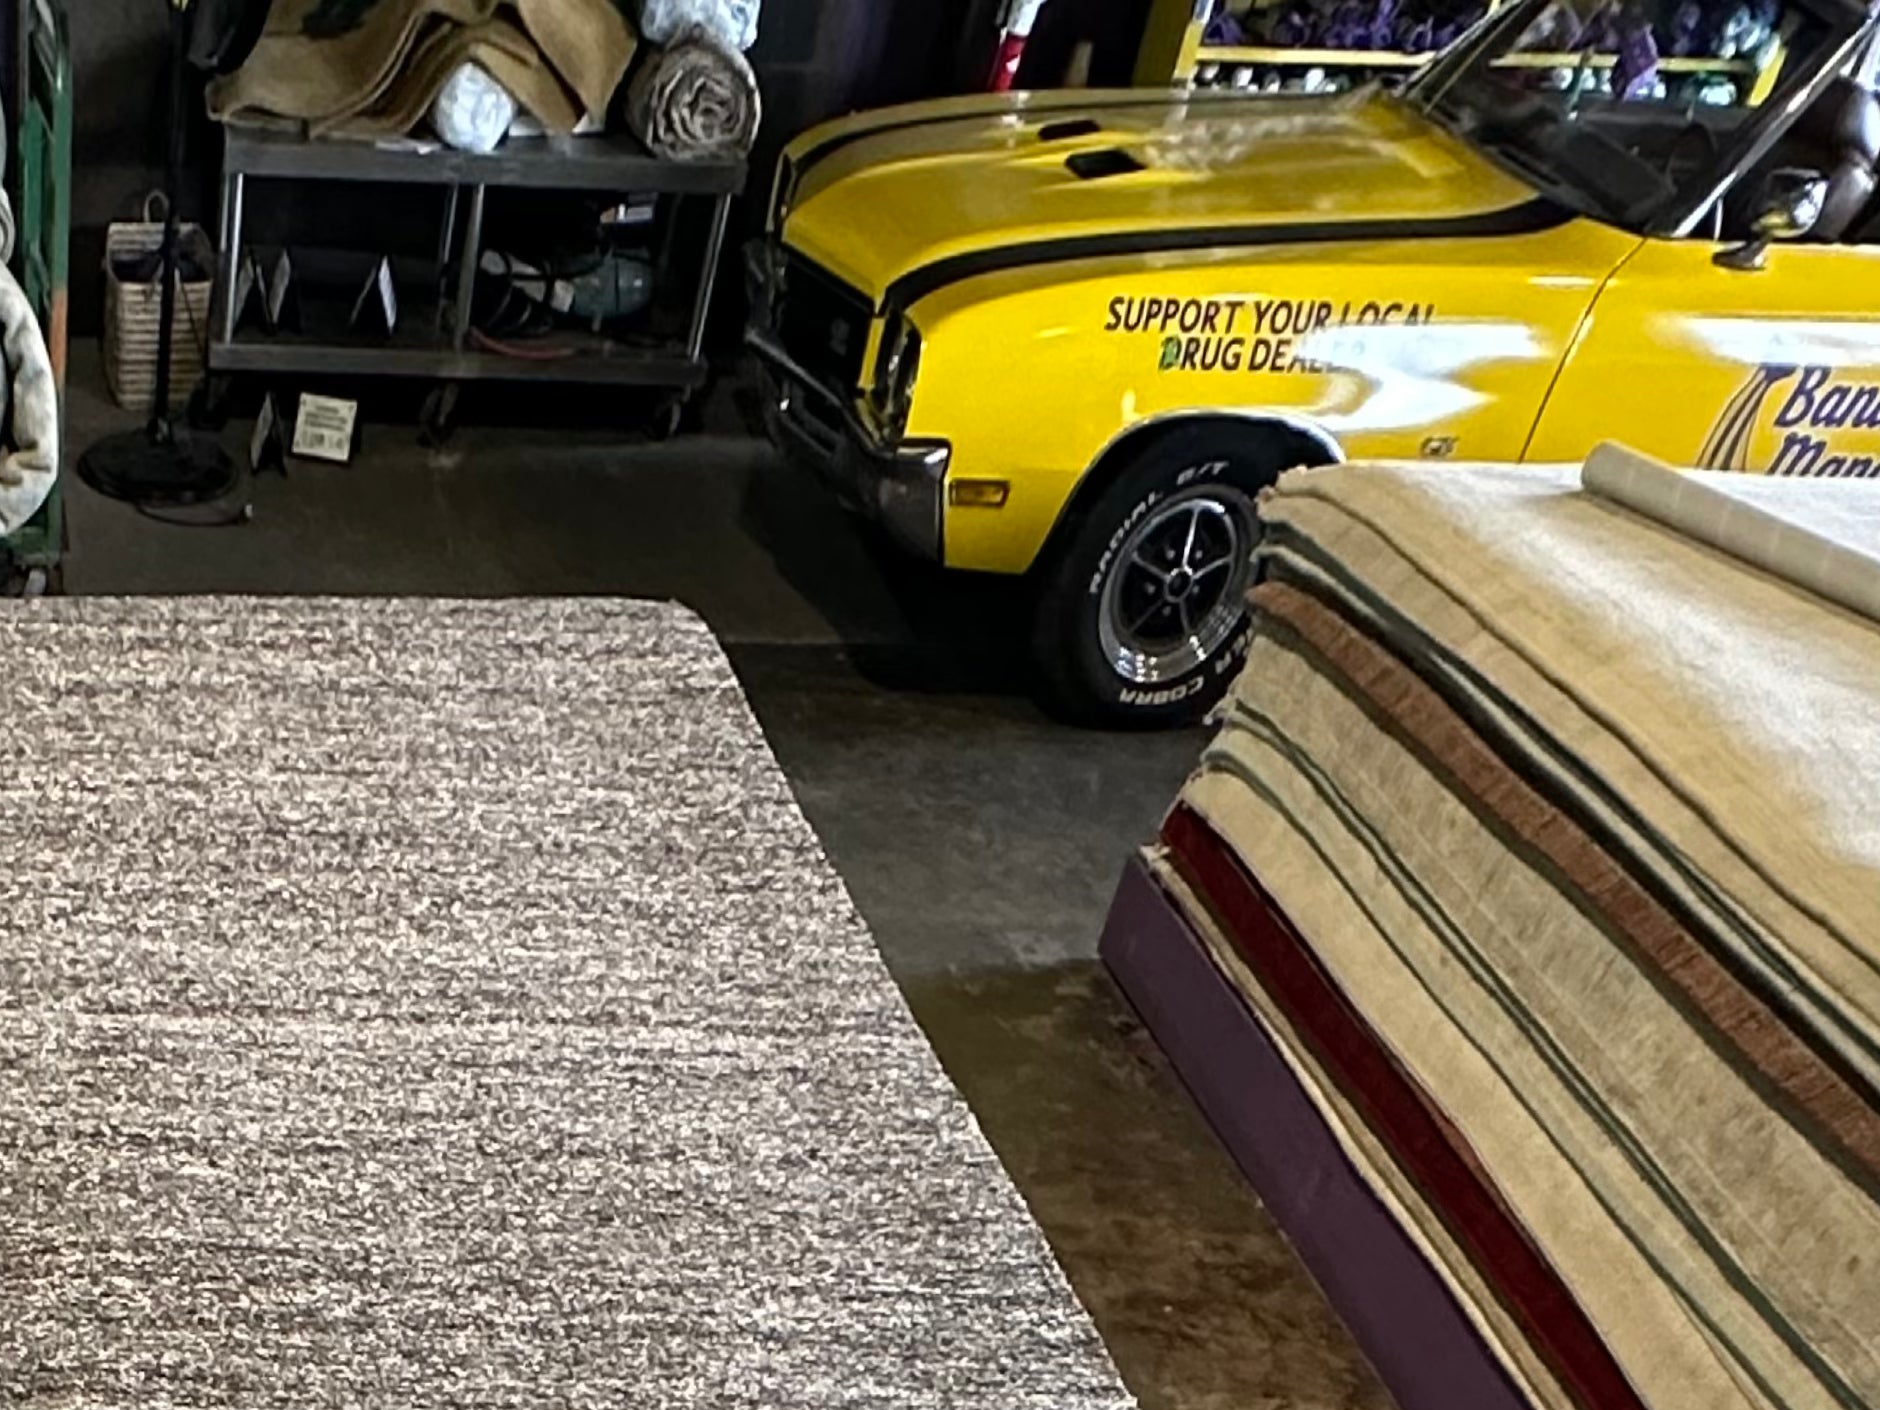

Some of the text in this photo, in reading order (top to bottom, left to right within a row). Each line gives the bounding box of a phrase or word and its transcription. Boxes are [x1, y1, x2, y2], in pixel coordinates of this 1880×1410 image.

[1104, 296, 1245, 334] SUPPORT
[1253, 299, 1333, 335] YOUR
[1157, 335, 1246, 371] DRUG
[1120, 675, 1206, 706] COBRA
